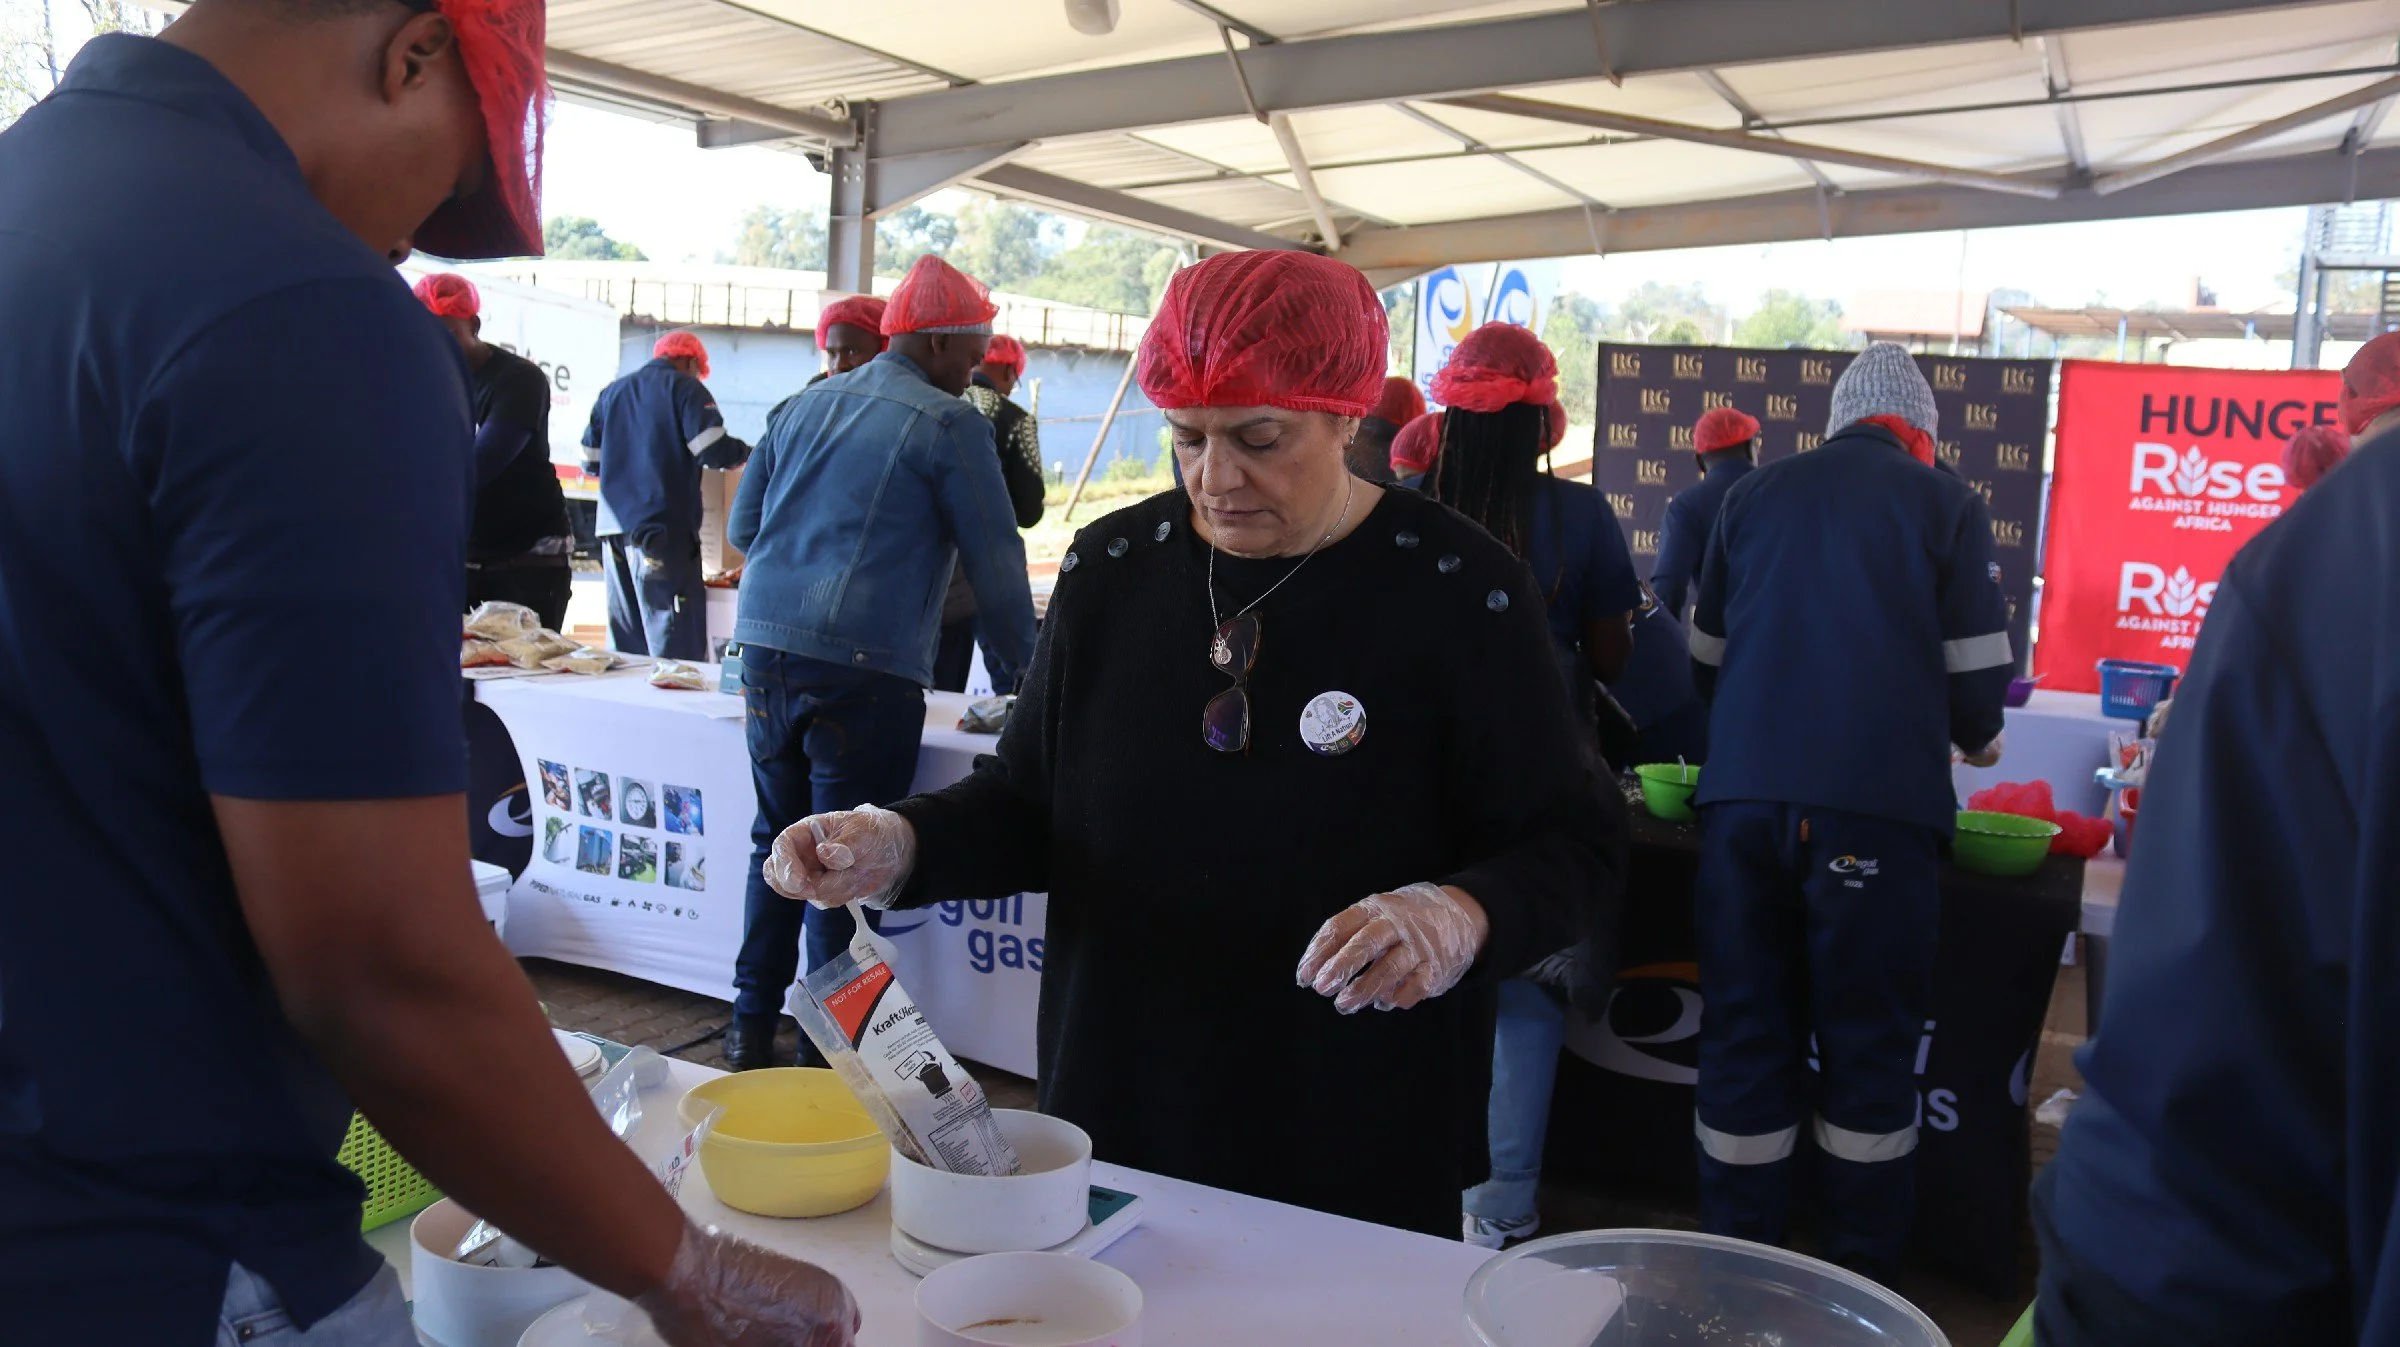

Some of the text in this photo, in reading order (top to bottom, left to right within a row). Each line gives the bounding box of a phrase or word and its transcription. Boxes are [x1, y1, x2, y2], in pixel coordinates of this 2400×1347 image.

[2139, 393, 2339, 441] HUNGE
[2129, 497, 2282, 519] AGAINST HUNGER
[2172, 515, 2233, 532] AFRICA
[2116, 615, 2193, 633] AGAINST
[2159, 635, 2196, 650] AFRI
[1336, 723, 1353, 733] Nation
[584, 894, 601, 903] GAS
[967, 928, 1047, 975] gas
[831, 992, 848, 1008] NOT
[847, 981, 863, 996] FOR
[861, 966, 888, 986] RESALE
